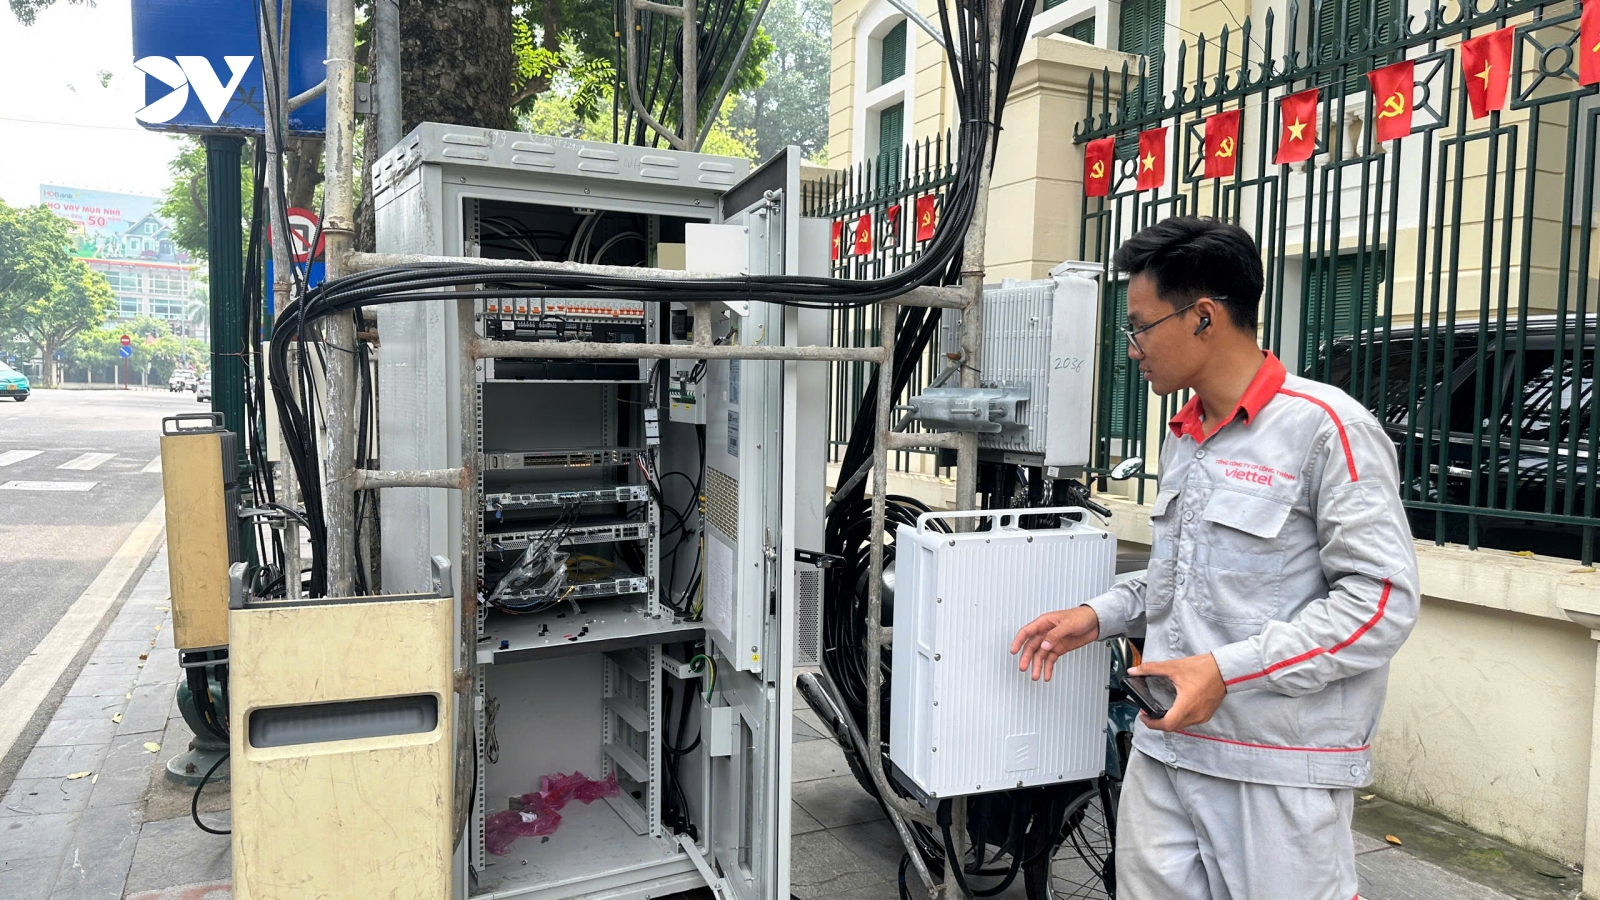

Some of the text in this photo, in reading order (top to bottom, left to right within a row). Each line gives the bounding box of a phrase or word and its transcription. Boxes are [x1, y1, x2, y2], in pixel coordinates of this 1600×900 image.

[45, 202, 61, 210] HO
[63, 204, 80, 212] VAY
[82, 206, 101, 214] MUA
[88, 215, 106, 227] 50
[1054, 357, 1085, 373] 2036
[1259, 465, 1275, 474] CÔNG
[1225, 468, 1273, 486] viettel
